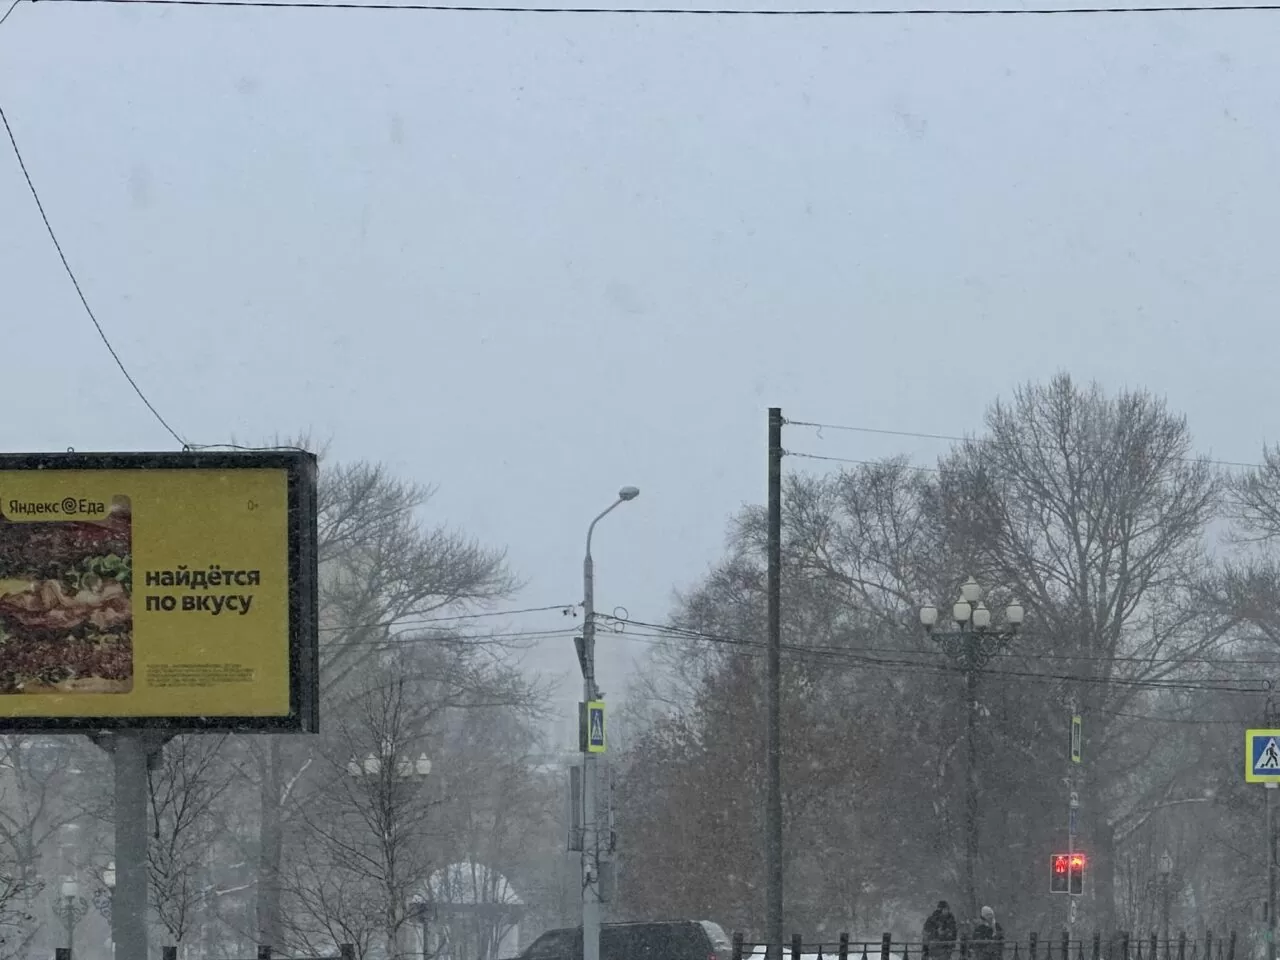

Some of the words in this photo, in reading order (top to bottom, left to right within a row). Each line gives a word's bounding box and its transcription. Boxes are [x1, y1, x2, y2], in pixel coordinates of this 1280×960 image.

[9, 499, 60, 516] Яндекс
[79, 499, 105, 515] Еда
[145, 565, 260, 590] найдётся
[145, 593, 176, 612] по
[182, 593, 253, 616] вкусу
